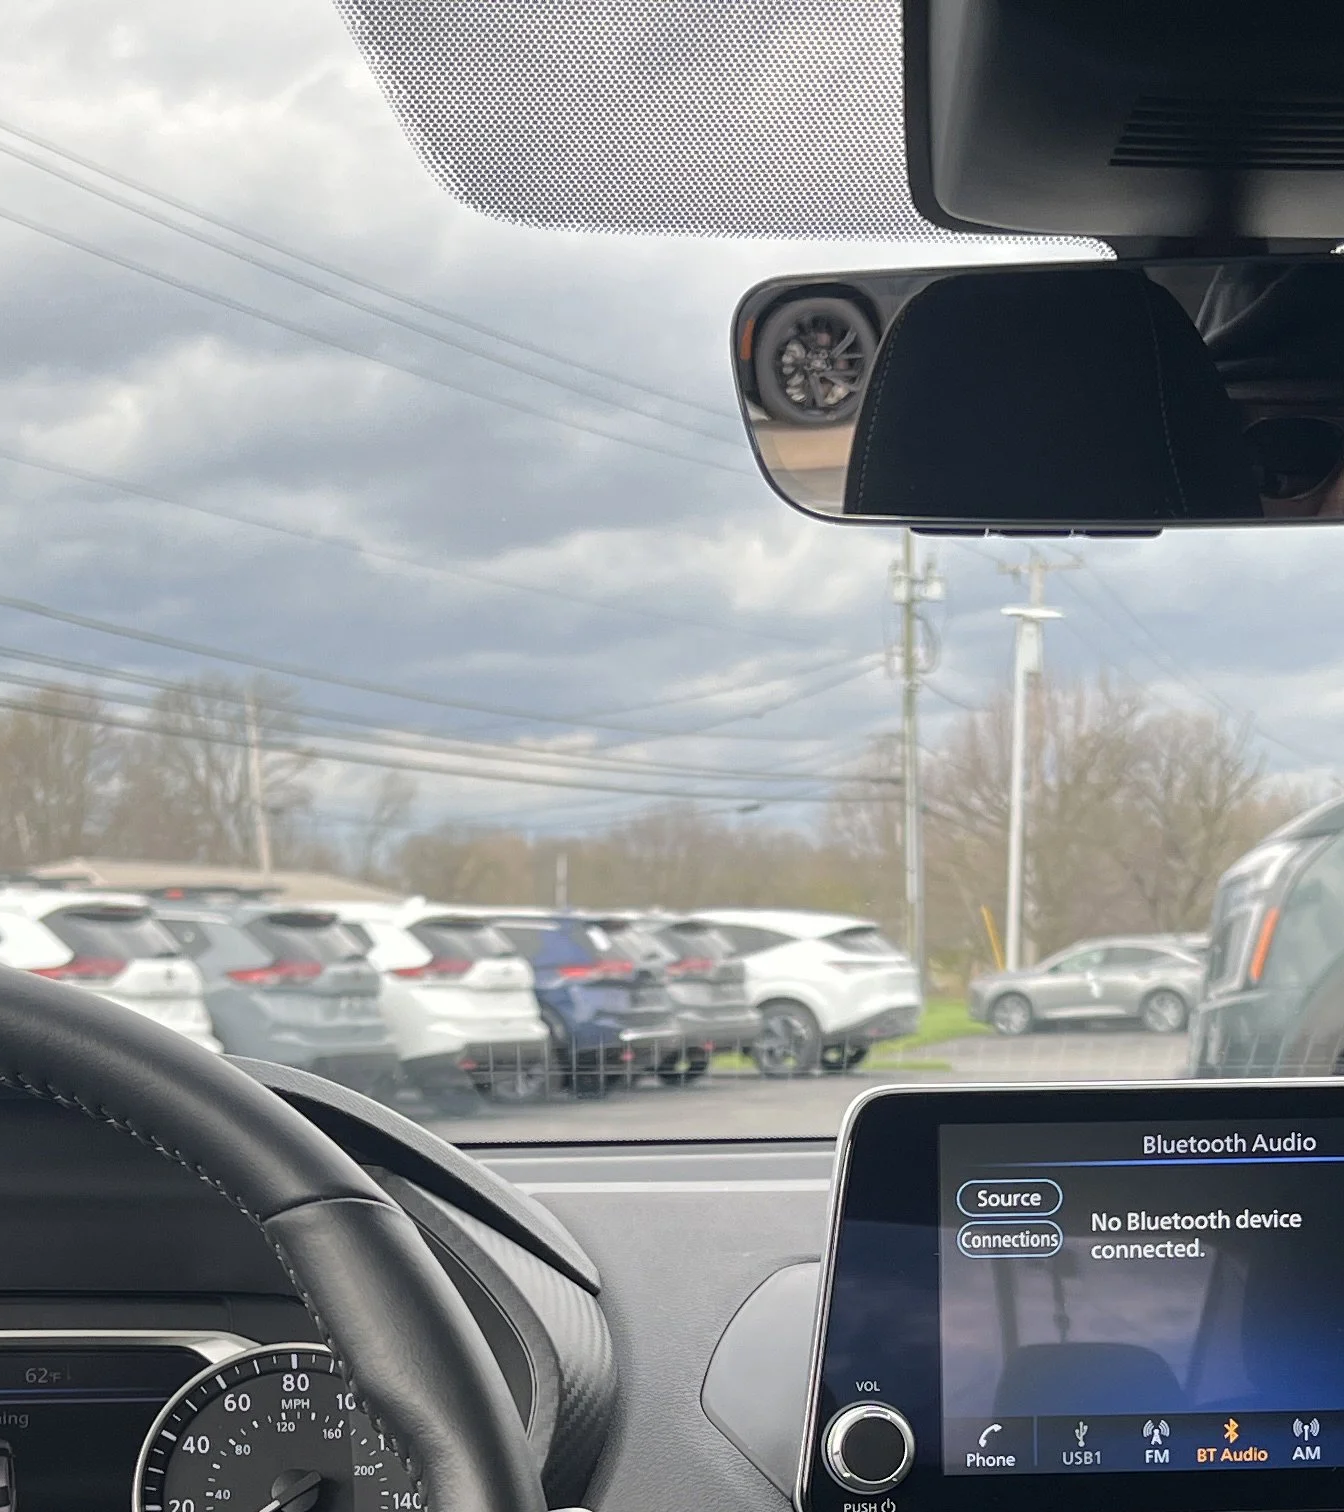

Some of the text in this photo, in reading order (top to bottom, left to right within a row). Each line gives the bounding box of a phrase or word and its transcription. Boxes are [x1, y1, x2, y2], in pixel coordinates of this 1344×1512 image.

[1143, 1132, 1317, 1155] Bluetooth Audio
[977, 1189, 1042, 1207] Source
[1091, 1208, 1303, 1232] No Bluetooth device
[961, 1229, 1058, 1248] Connections
[1090, 1238, 1206, 1260] connected.
[282, 1373, 310, 1391] 80
[855, 1380, 881, 1392] VOL
[223, 1393, 251, 1412] 60
[280, 1398, 310, 1410] MPH
[336, 1392, 357, 1411] 10
[276, 1421, 296, 1432] 120
[322, 1428, 342, 1440] 160
[182, 1435, 210, 1454] 40
[234, 1444, 252, 1455] 80
[966, 1453, 1016, 1468] Phone
[1062, 1450, 1102, 1466] USB1
[1145, 1449, 1170, 1464] FM
[1196, 1446, 1269, 1463] BT Audio
[1292, 1446, 1321, 1460] AM
[354, 1465, 375, 1476] 200
[214, 1489, 231, 1500] 40
